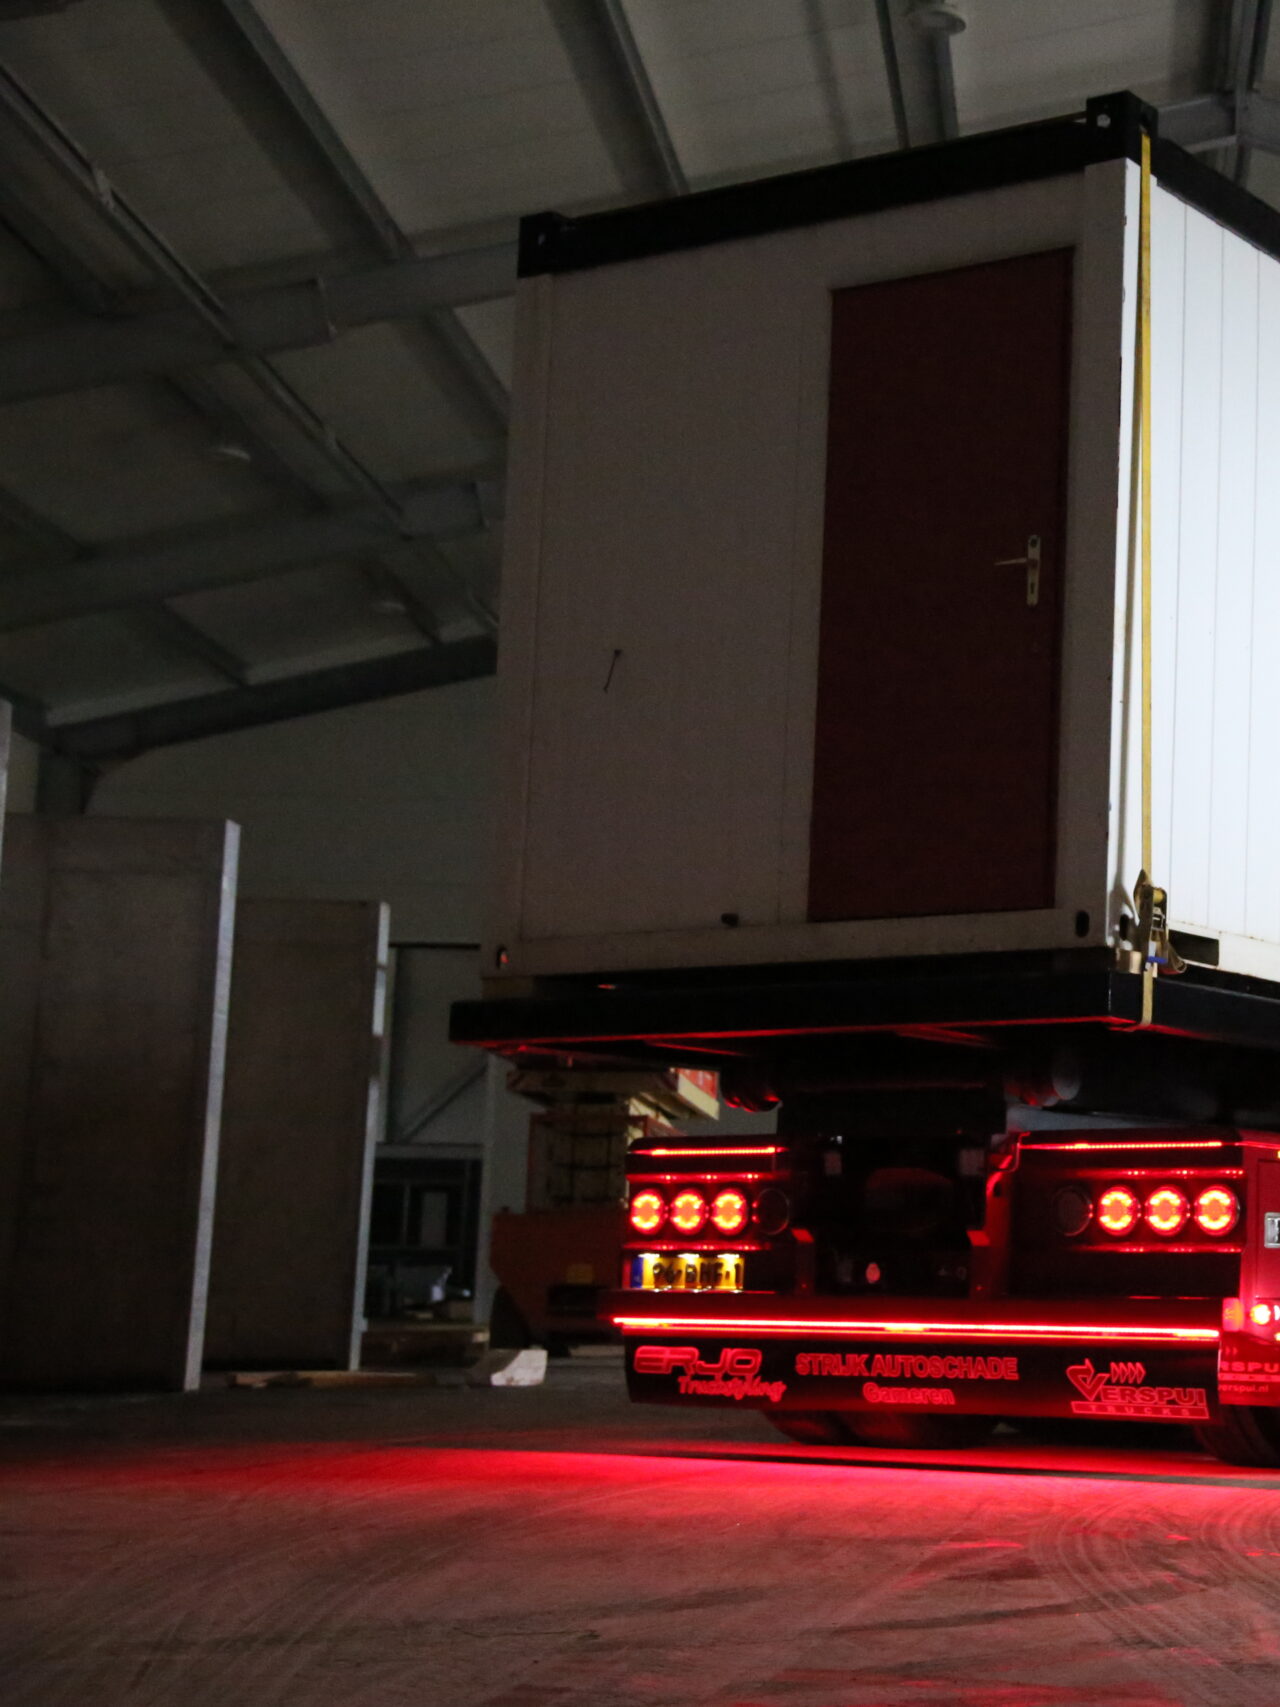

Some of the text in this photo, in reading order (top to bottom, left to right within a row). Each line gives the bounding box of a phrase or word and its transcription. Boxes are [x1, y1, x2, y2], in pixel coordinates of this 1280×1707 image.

[634, 1345, 762, 1376] ERJO
[795, 1352, 1019, 1380] STRIJK AUTOSCHADE
[862, 1382, 957, 1406] Gameren
[1088, 1403, 1192, 1418] TRUCKS
